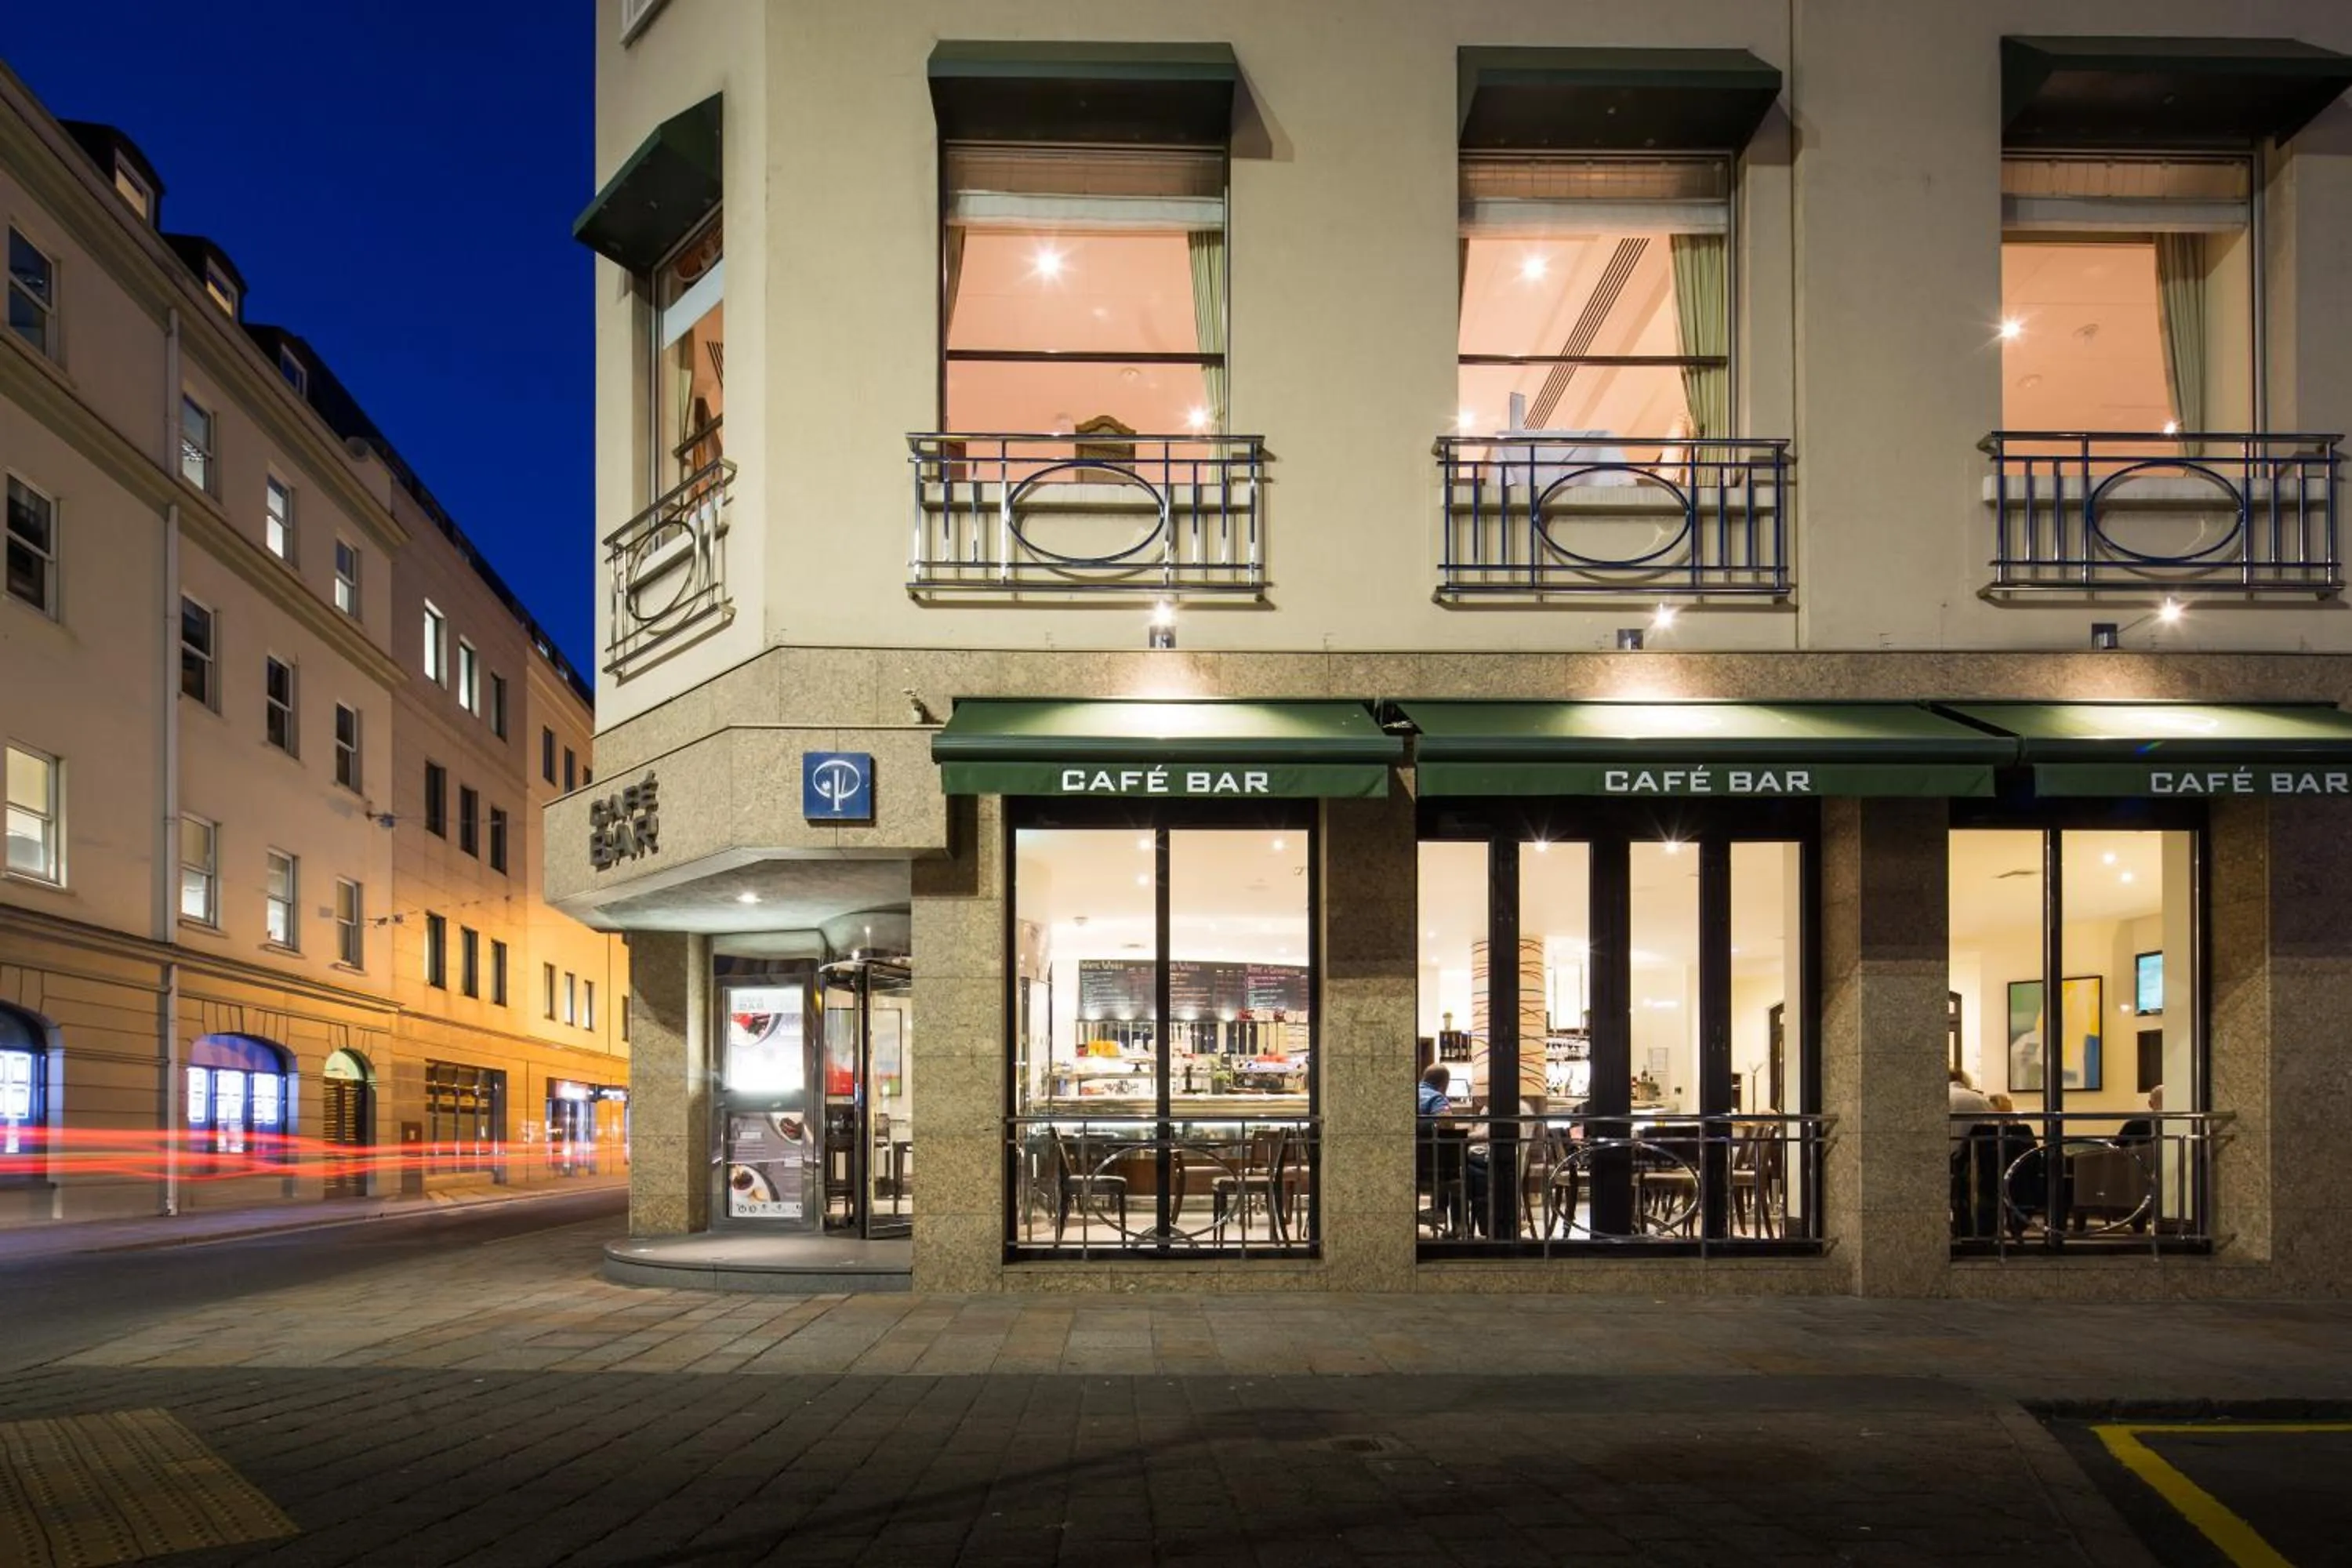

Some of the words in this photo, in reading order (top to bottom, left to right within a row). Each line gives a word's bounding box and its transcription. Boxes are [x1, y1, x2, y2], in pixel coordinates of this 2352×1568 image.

[1062, 764, 1169, 793] CAFÉ
[1186, 771, 1270, 793] BAR
[1604, 764, 1712, 793] CAFÉ
[1728, 771, 1812, 793] BAR
[2150, 765, 2255, 793] CAFÉ
[2270, 772, 2350, 793] BAR
[590, 770, 659, 828] CAFÉ
[590, 815, 659, 872] BAR
